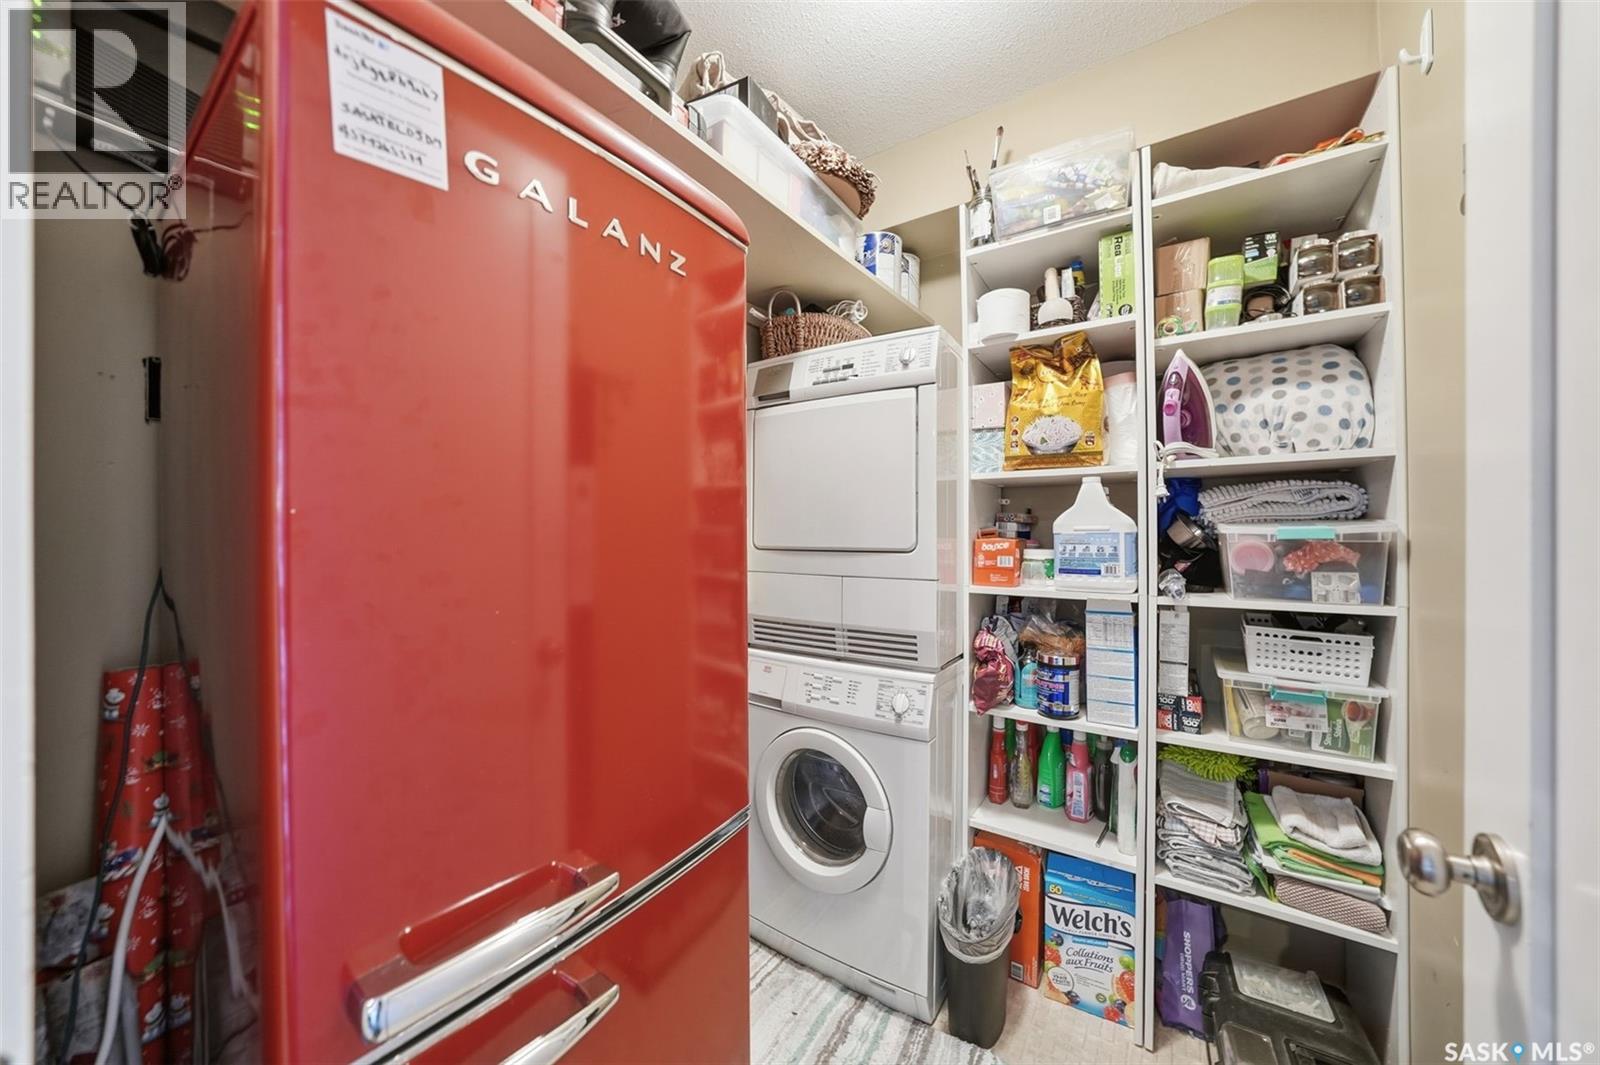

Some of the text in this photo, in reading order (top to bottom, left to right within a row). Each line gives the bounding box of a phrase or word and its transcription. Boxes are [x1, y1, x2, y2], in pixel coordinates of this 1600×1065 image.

[463, 149, 688, 277] GALANZ
[981, 541, 1010, 552] bounce
[1049, 884, 1063, 896] 60
[1049, 902, 1132, 938] Welch's
[1065, 946, 1114, 965] Collations
[1183, 930, 1195, 995] SHOPPERS
[1065, 957, 1114, 974] aux Fruits
